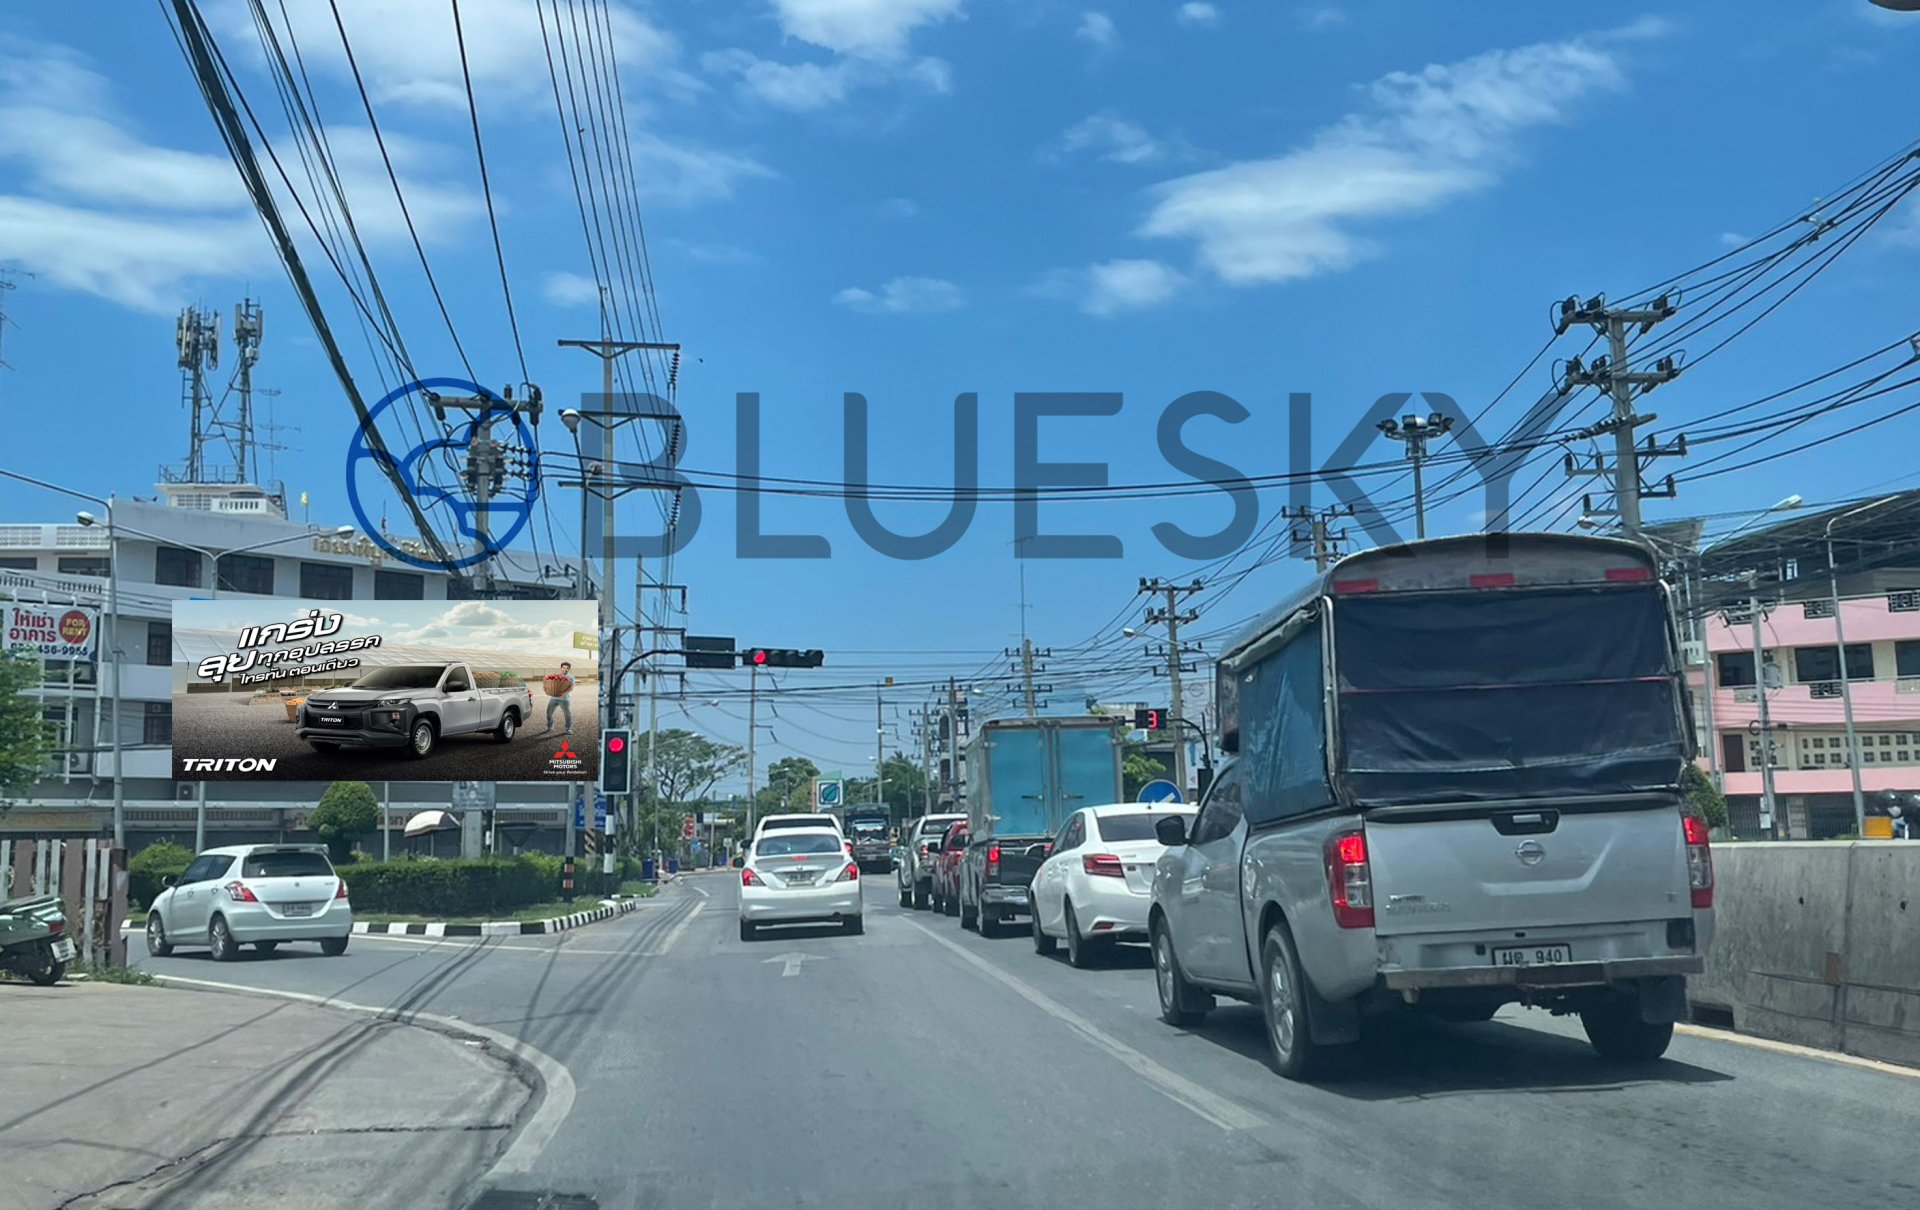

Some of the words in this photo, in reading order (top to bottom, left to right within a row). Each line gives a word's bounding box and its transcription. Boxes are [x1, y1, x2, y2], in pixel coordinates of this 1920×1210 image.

[12, 607, 54, 628] ให้เช่า
[66, 618, 85, 627] FOR
[9, 628, 57, 642] อาคาร
[62, 626, 87, 636] RENT
[238, 609, 342, 649] แกร่ง
[197, 650, 257, 683] ลุย
[257, 635, 381, 667] ทุกอุปสรรค
[240, 668, 286, 685] ไทรทัน
[289, 657, 359, 677] ตอนเดียว
[1147, 710, 1159, 730] 3
[182, 758, 277, 772] TRITON
[1535, 949, 1562, 964] 940
